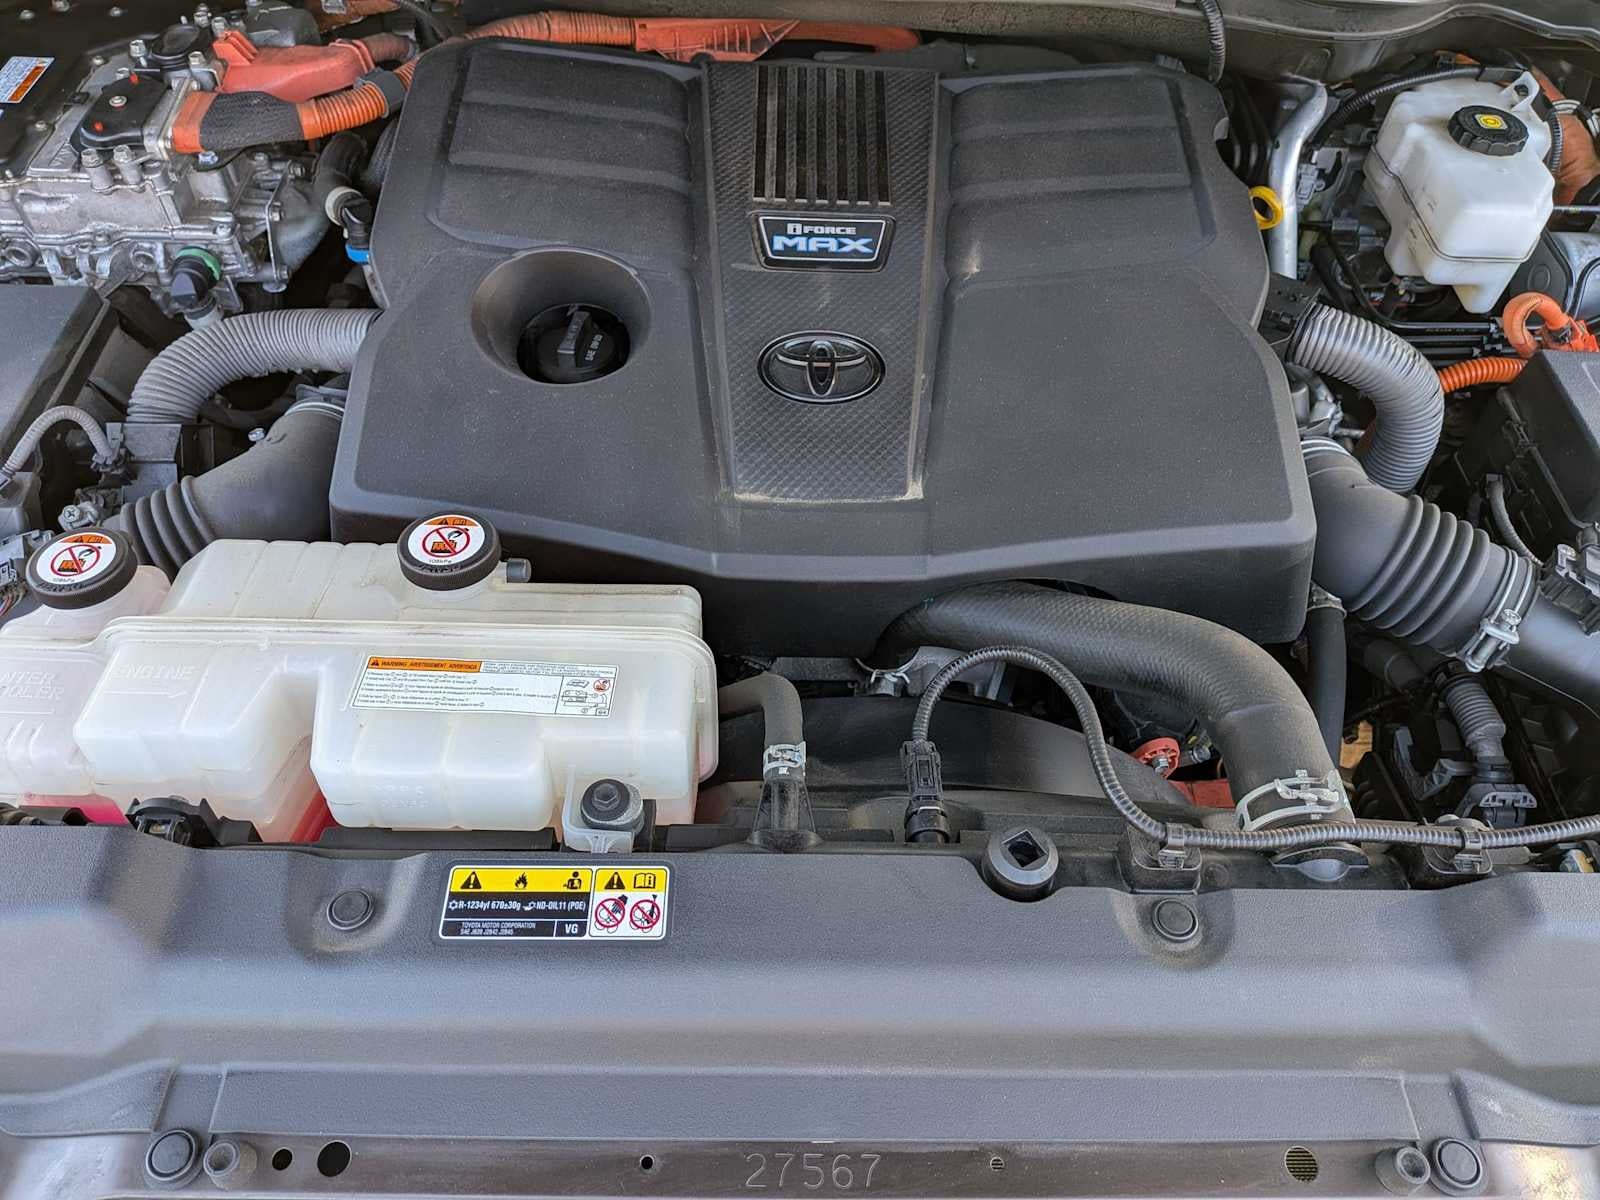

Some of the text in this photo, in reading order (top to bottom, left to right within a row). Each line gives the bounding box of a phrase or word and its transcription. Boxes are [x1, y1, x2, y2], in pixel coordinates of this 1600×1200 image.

[772, 236, 874, 253] MAX
[110, 664, 196, 680] ENGINE
[458, 900, 490, 911] R-1234yf
[567, 901, 586, 911] (POE)
[565, 923, 579, 935] VG
[744, 1152, 881, 1190] 27567
